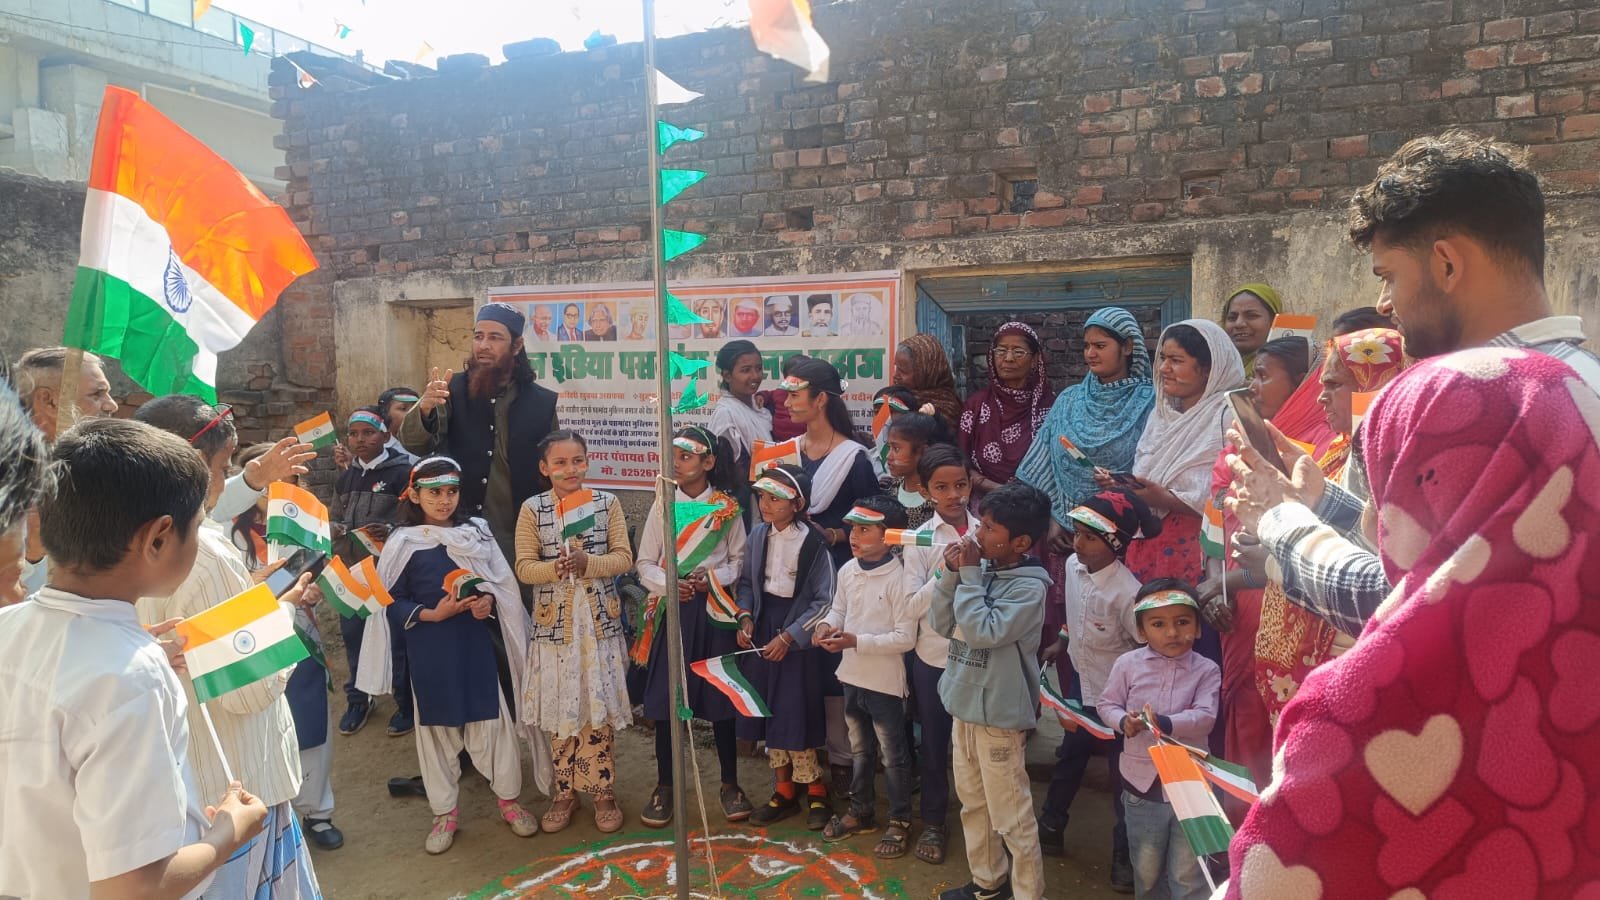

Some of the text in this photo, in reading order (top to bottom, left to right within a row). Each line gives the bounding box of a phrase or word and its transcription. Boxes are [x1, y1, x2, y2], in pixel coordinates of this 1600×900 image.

[550, 344, 614, 384] इंडिया
[588, 450, 660, 463] नगर पंचायत गि
